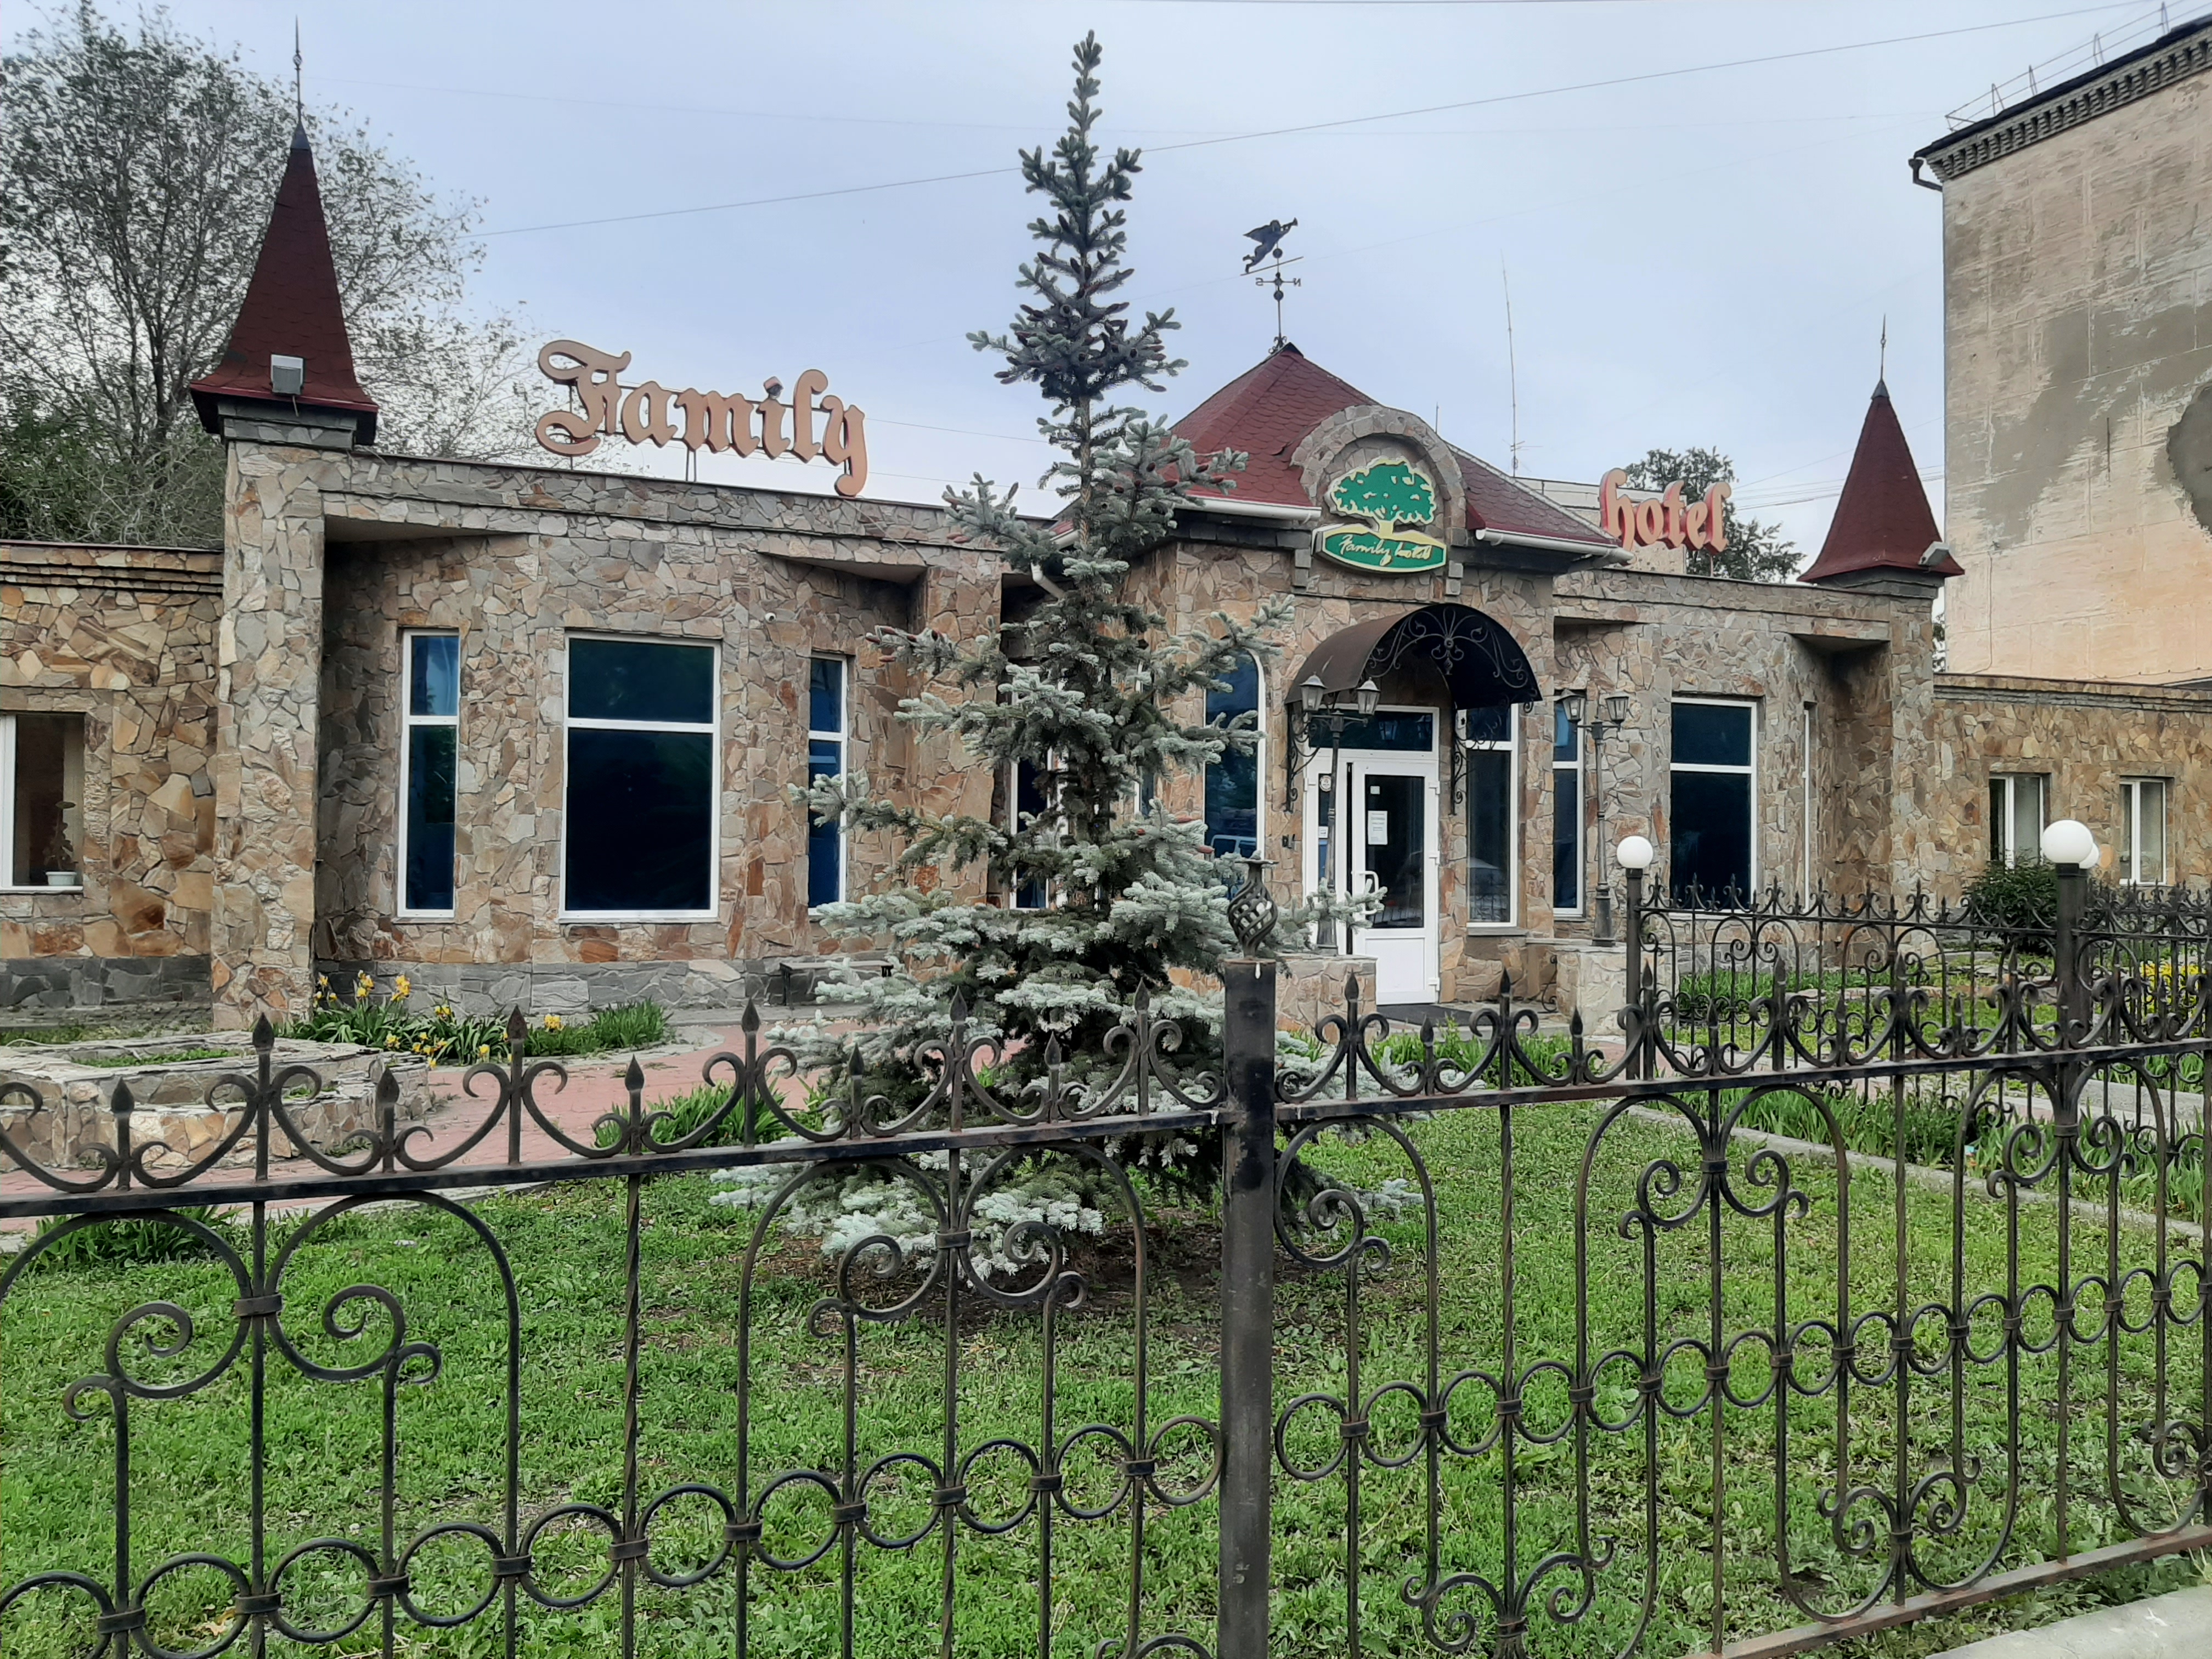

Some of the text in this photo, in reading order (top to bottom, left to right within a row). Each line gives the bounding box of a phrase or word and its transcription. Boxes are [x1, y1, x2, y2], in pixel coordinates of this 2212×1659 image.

[535, 339, 868, 499] Family
[1339, 534, 1392, 566] Family
[1599, 467, 1732, 555] hotel
